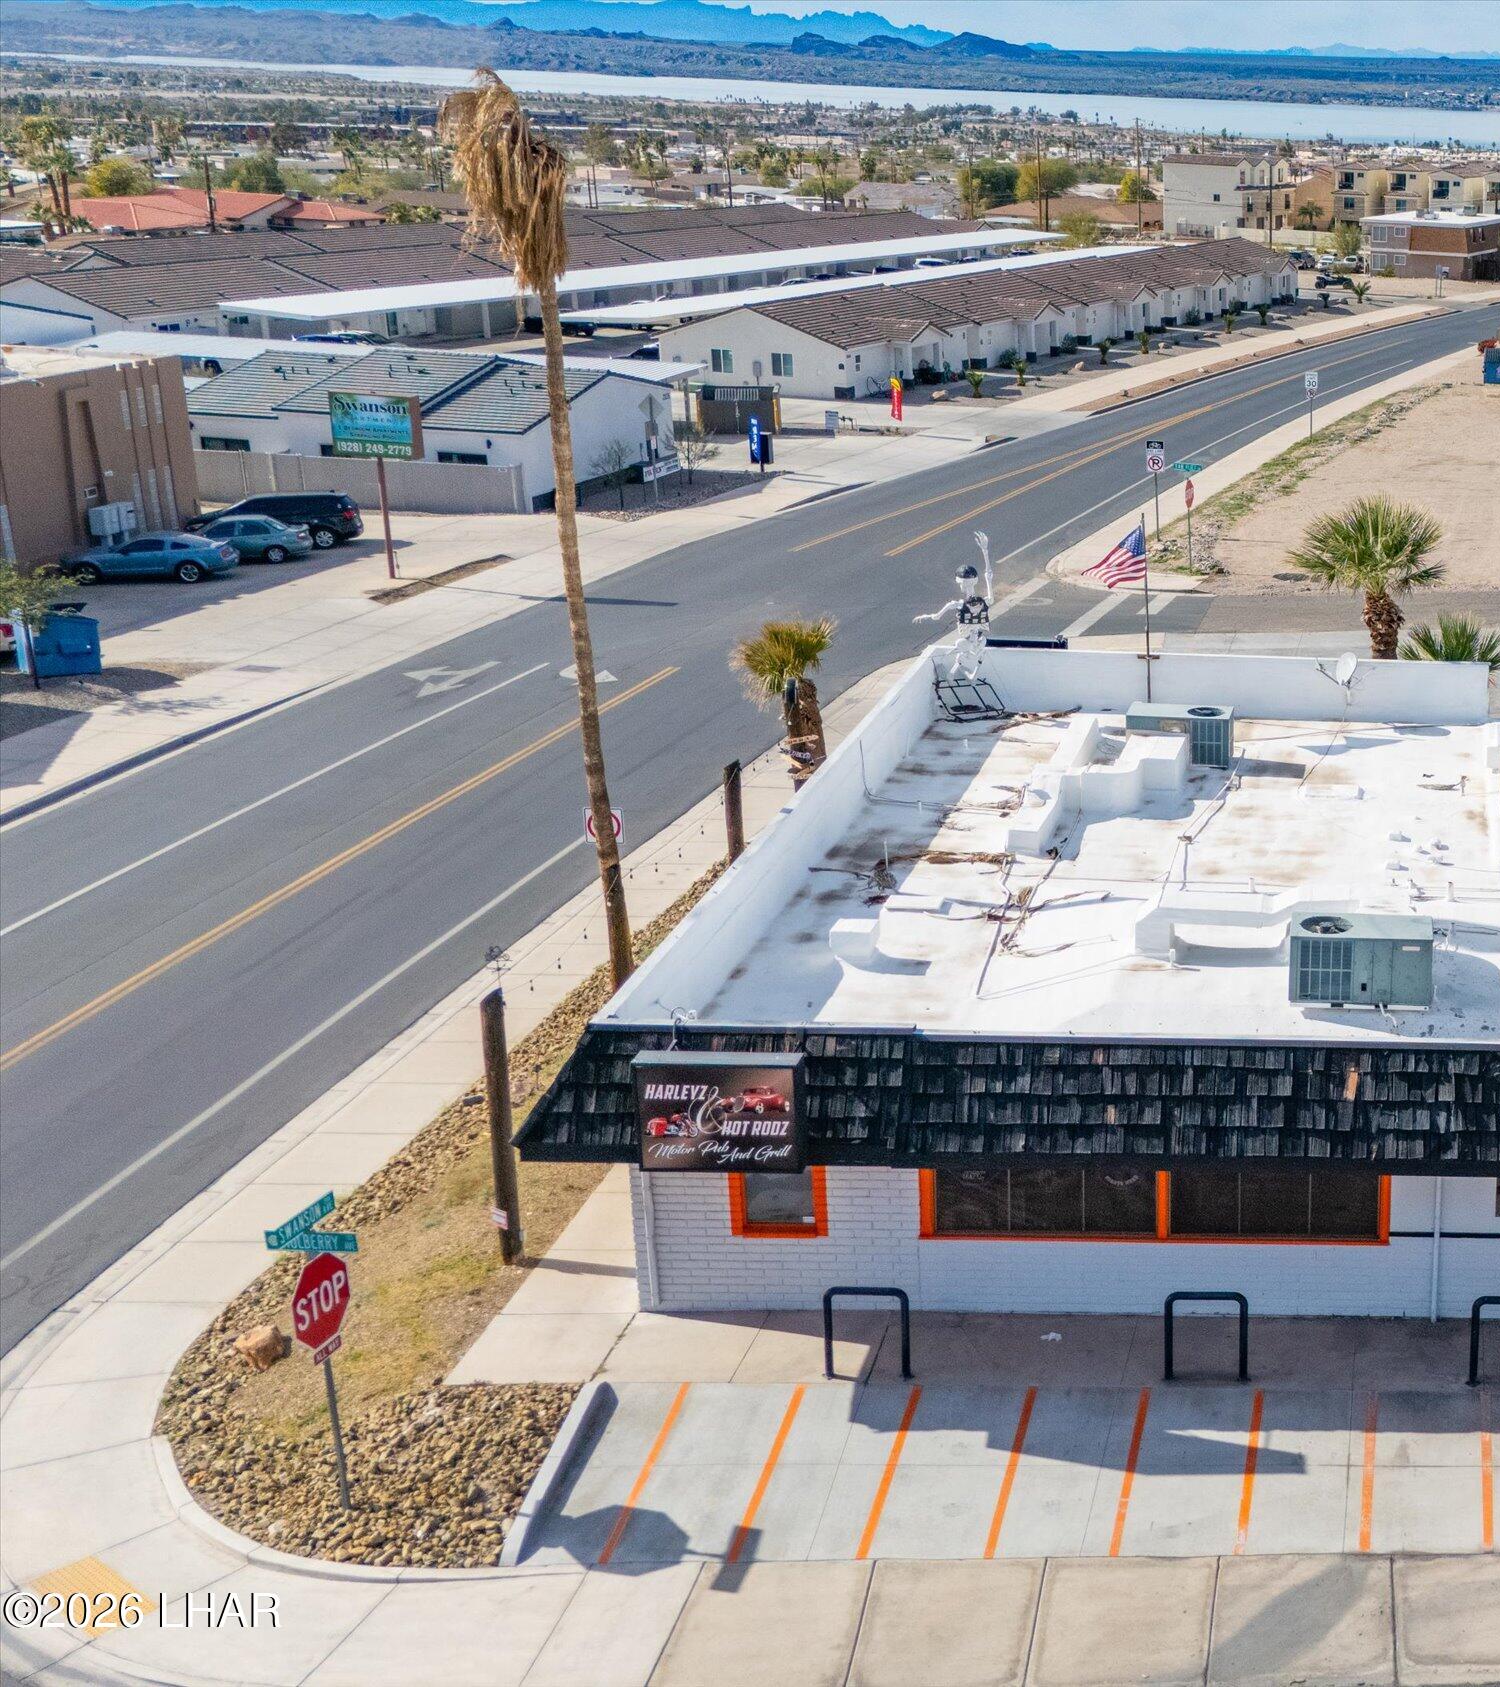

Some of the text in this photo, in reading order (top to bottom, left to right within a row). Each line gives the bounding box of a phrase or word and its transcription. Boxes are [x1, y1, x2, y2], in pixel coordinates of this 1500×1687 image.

[1306, 379, 1317, 388] 30
[333, 394, 408, 415] Swanson
[337, 441, 412, 456] (928) 249-2779
[644, 1084, 709, 1100] HARLEYZ
[721, 1120, 790, 1136] HOT RODZ
[649, 1140, 730, 1159] Motor Pub
[717, 1144, 793, 1164] And Grill
[278, 1203, 322, 1244] SWANSON
[286, 1233, 339, 1249] ULBERRY
[296, 1269, 346, 1331] STOP
